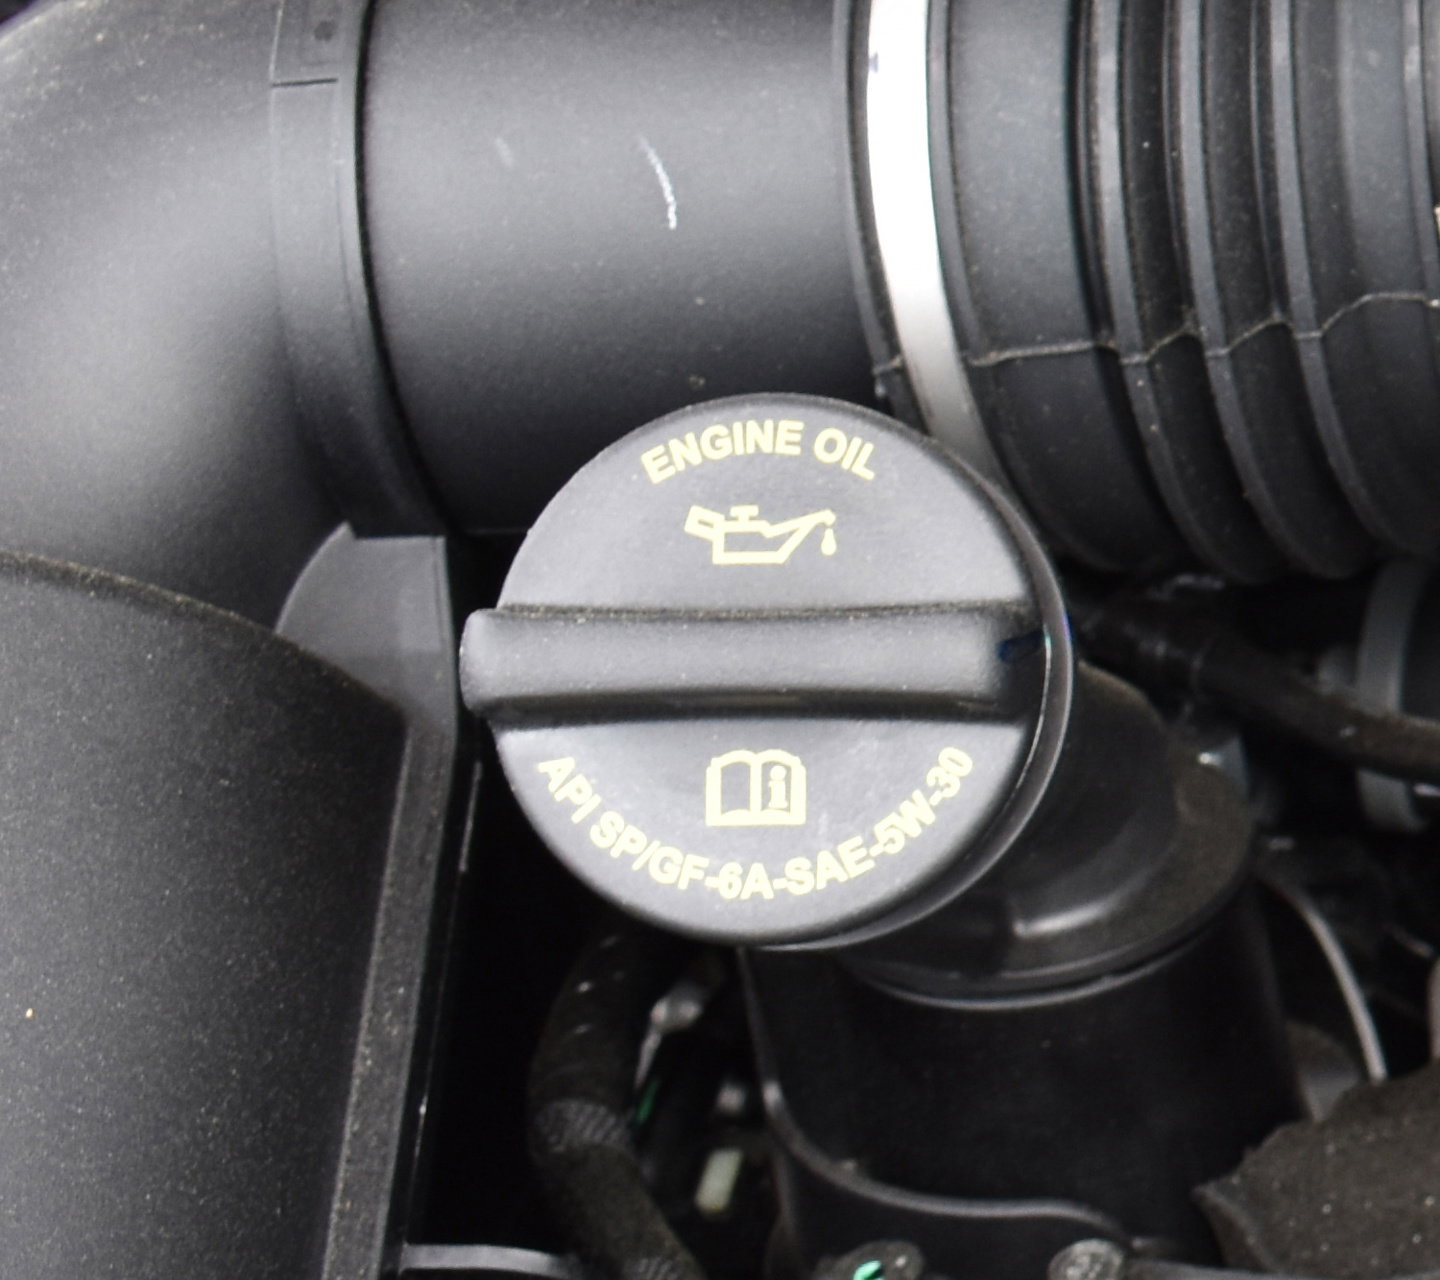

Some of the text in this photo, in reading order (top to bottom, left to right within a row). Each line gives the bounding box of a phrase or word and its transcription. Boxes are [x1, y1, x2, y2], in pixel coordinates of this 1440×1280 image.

[640, 418, 877, 484] ENGINE OIL
[538, 754, 600, 825] API
